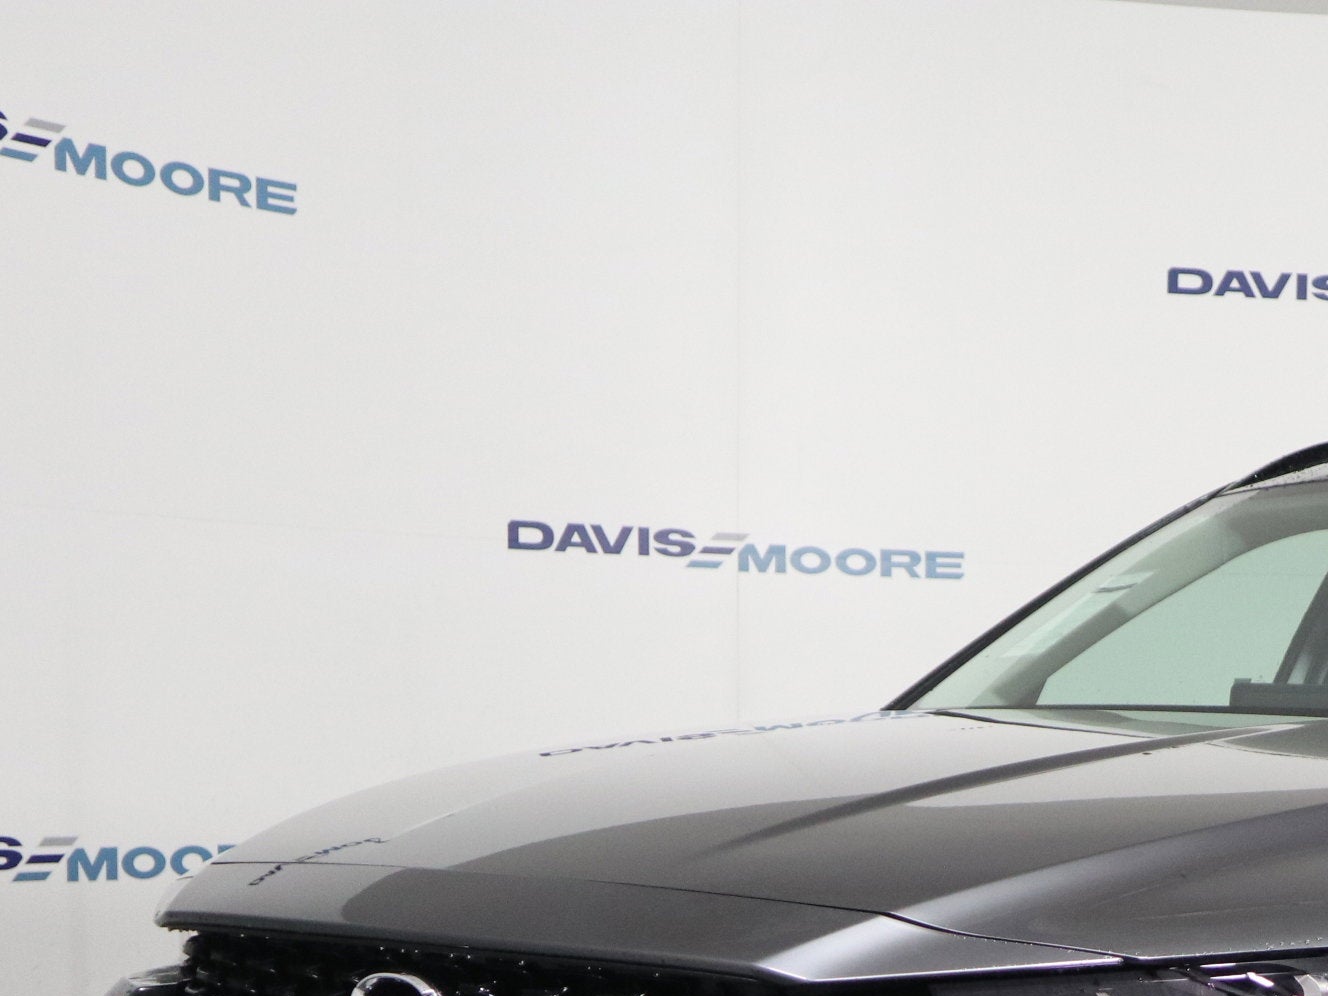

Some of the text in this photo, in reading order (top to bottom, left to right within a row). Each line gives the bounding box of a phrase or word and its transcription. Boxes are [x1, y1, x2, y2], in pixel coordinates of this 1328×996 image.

[54, 137, 297, 215] MOORE
[507, 519, 965, 580] DAVIS MOORE
